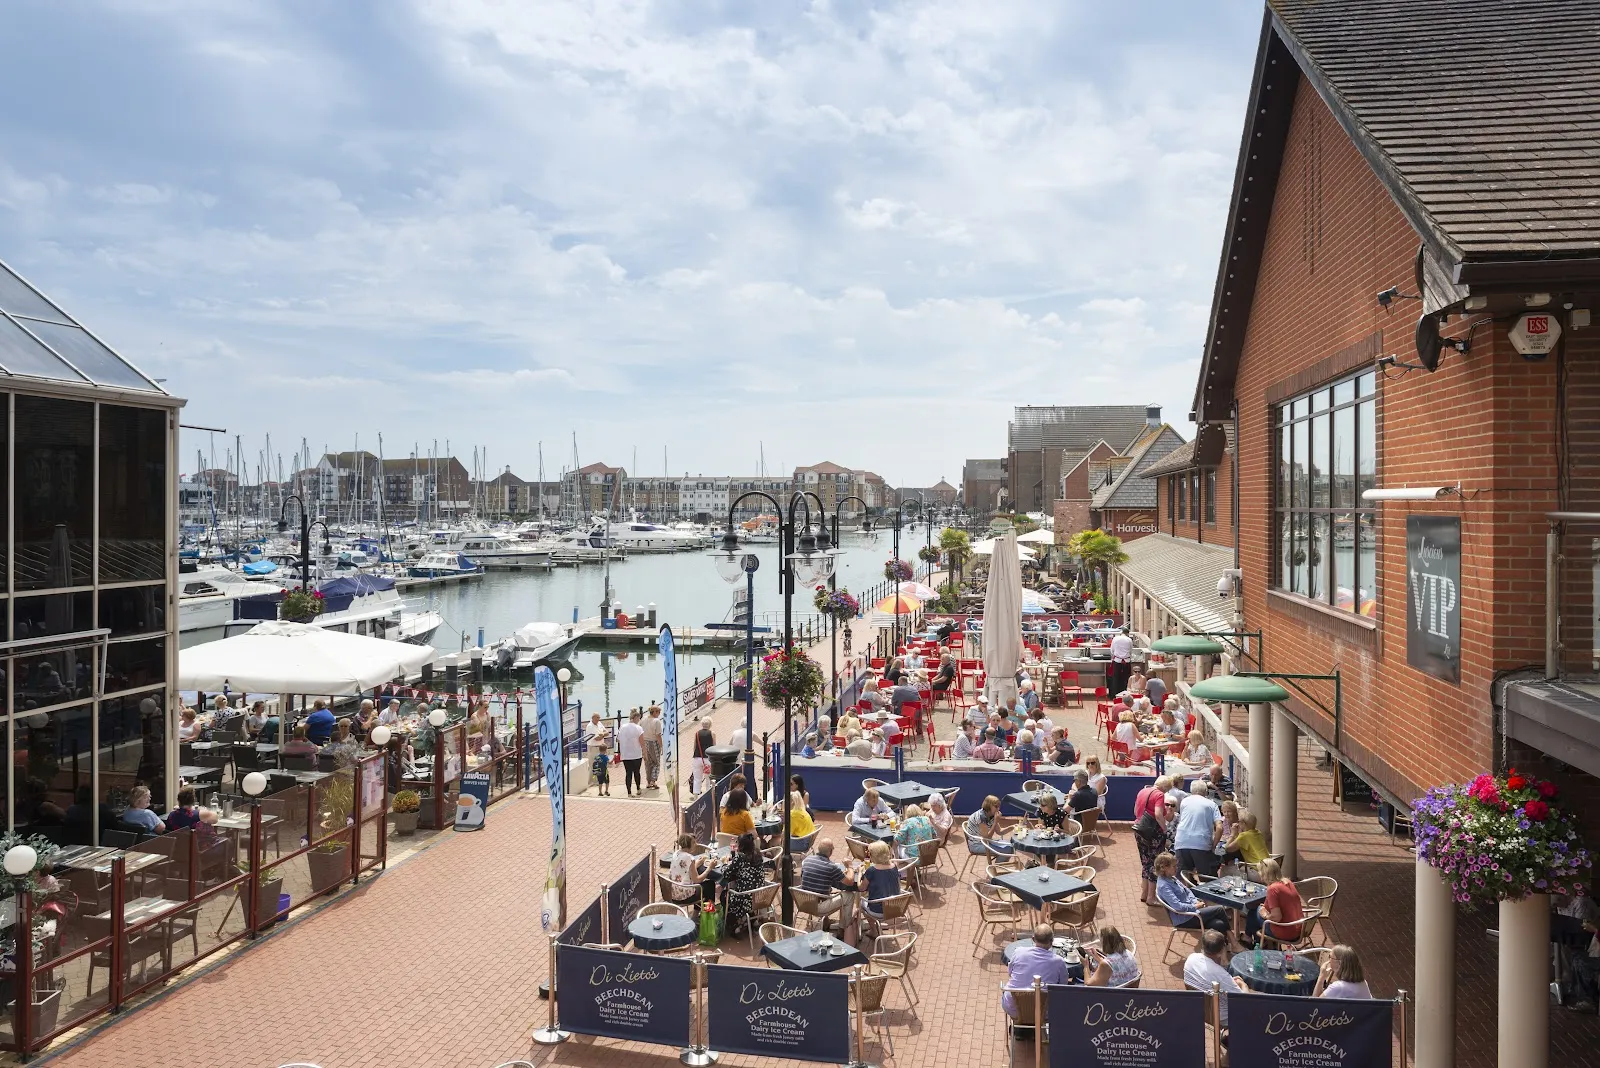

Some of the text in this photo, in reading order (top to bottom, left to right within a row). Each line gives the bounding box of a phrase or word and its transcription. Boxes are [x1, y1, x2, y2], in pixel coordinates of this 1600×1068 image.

[1529, 319, 1547, 331] ESS
[1411, 572, 1456, 639] VIP
[539, 710, 550, 758] ICE
[589, 962, 660, 985] Di Lieto's
[594, 988, 654, 1010] BEECHDEAN
[740, 980, 816, 1004] Di Lieto's
[600, 1006, 616, 1014] Dairy
[607, 1001, 642, 1010] Farmhouse
[1084, 999, 1168, 1026] Di Lieto's
[746, 1006, 809, 1028] BEECHDEAN
[760, 1020, 796, 1028] Farmhouse
[1265, 1008, 1354, 1035] Di Lieto's
[750, 1024, 768, 1033] Dairy
[1091, 1027, 1162, 1049] BEECHDEAN
[1097, 1048, 1117, 1056] Dairy
[1272, 1037, 1347, 1059] BEECHDEAN
[1288, 1050, 1332, 1059] Farmhouse
[1279, 1058, 1300, 1066] Dairy
